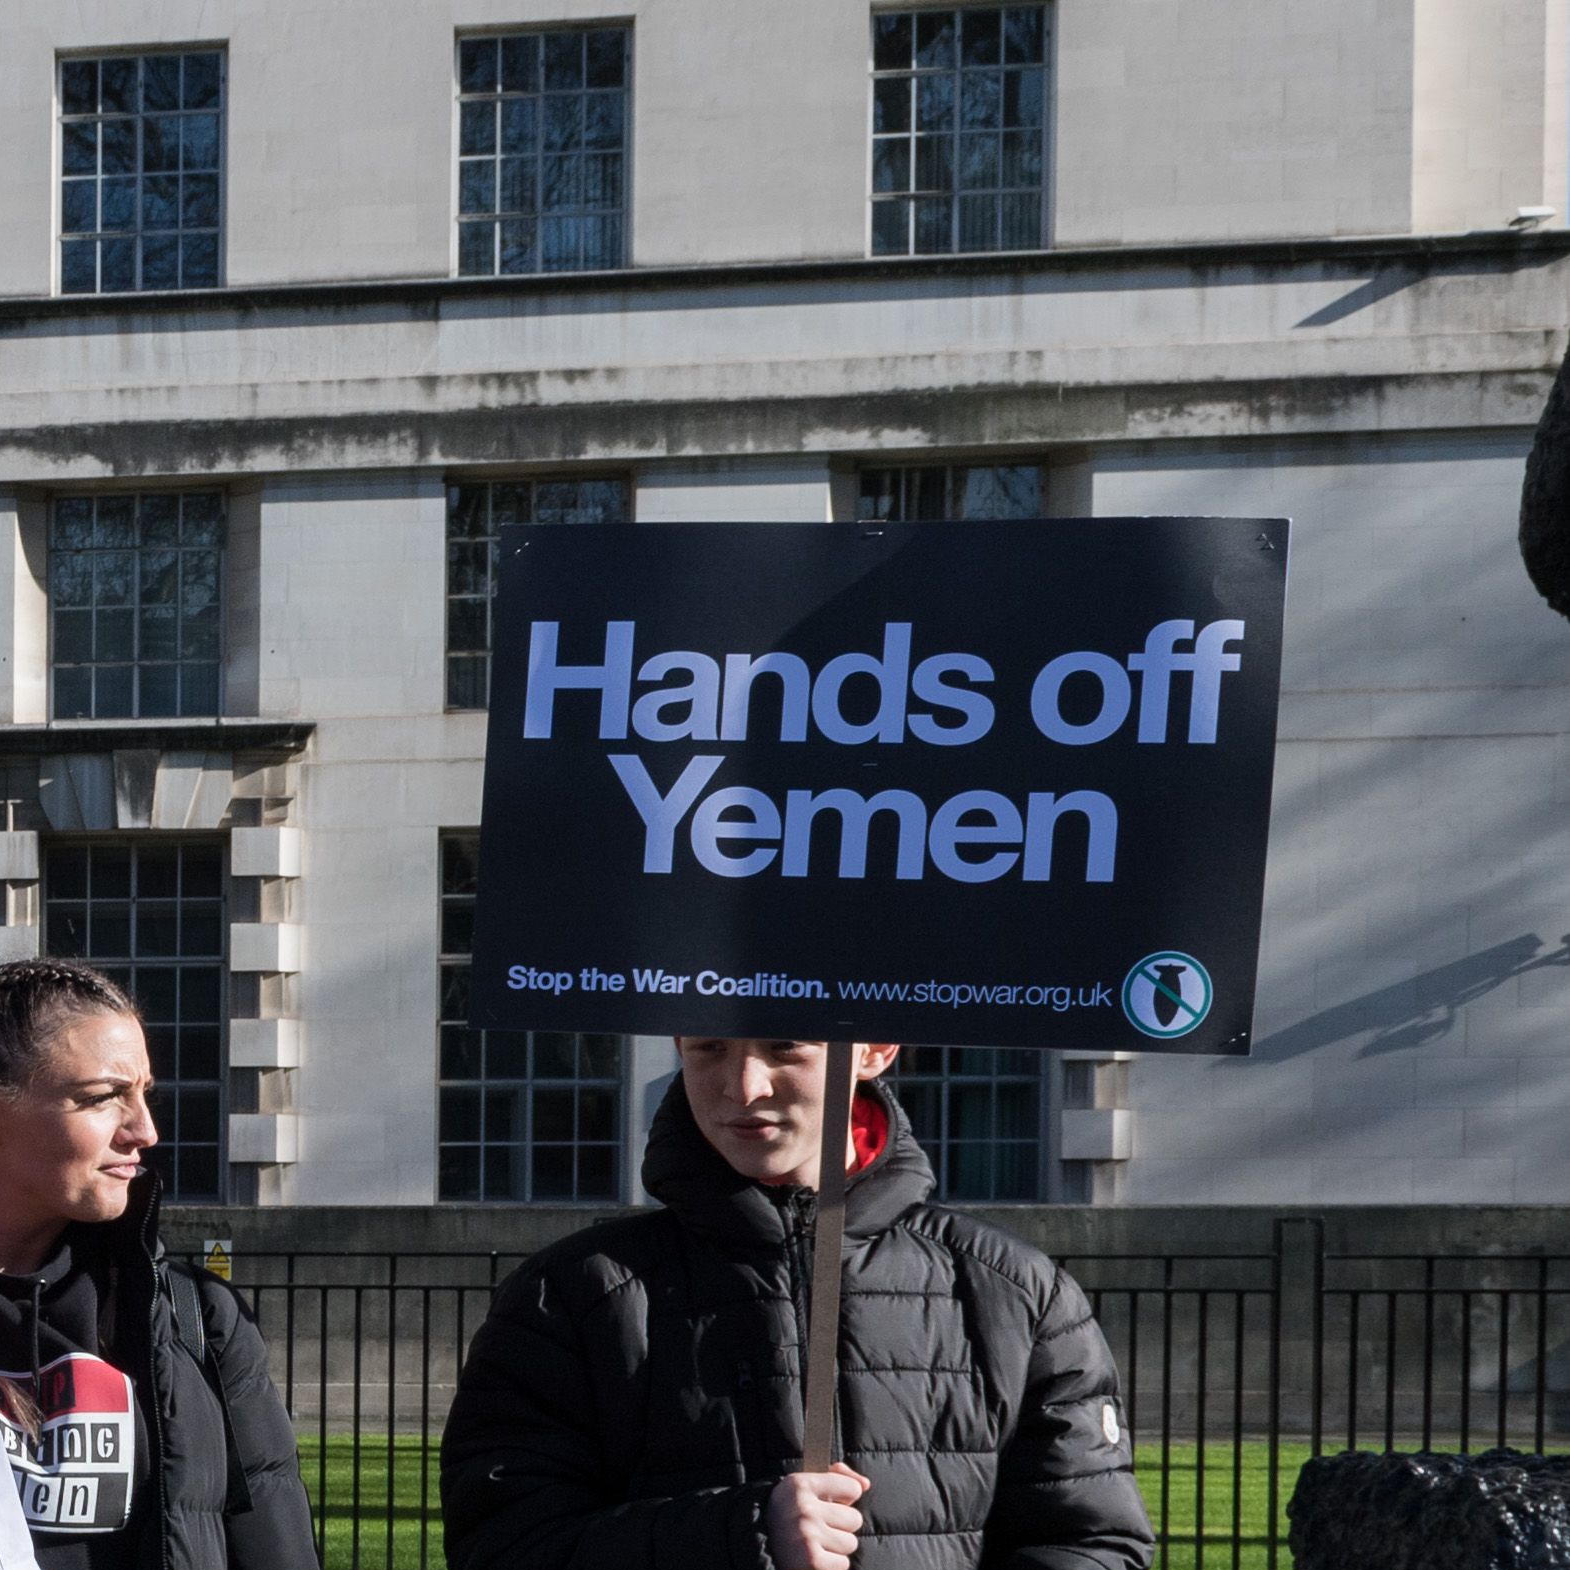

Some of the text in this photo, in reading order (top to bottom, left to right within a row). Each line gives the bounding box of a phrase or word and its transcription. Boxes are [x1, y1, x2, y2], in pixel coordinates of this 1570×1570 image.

[524, 619, 1245, 745] Hands off
[608, 755, 1117, 883] Yemen
[507, 964, 1112, 1012] Stop the War Coalition. www.stopwar.org.uk
